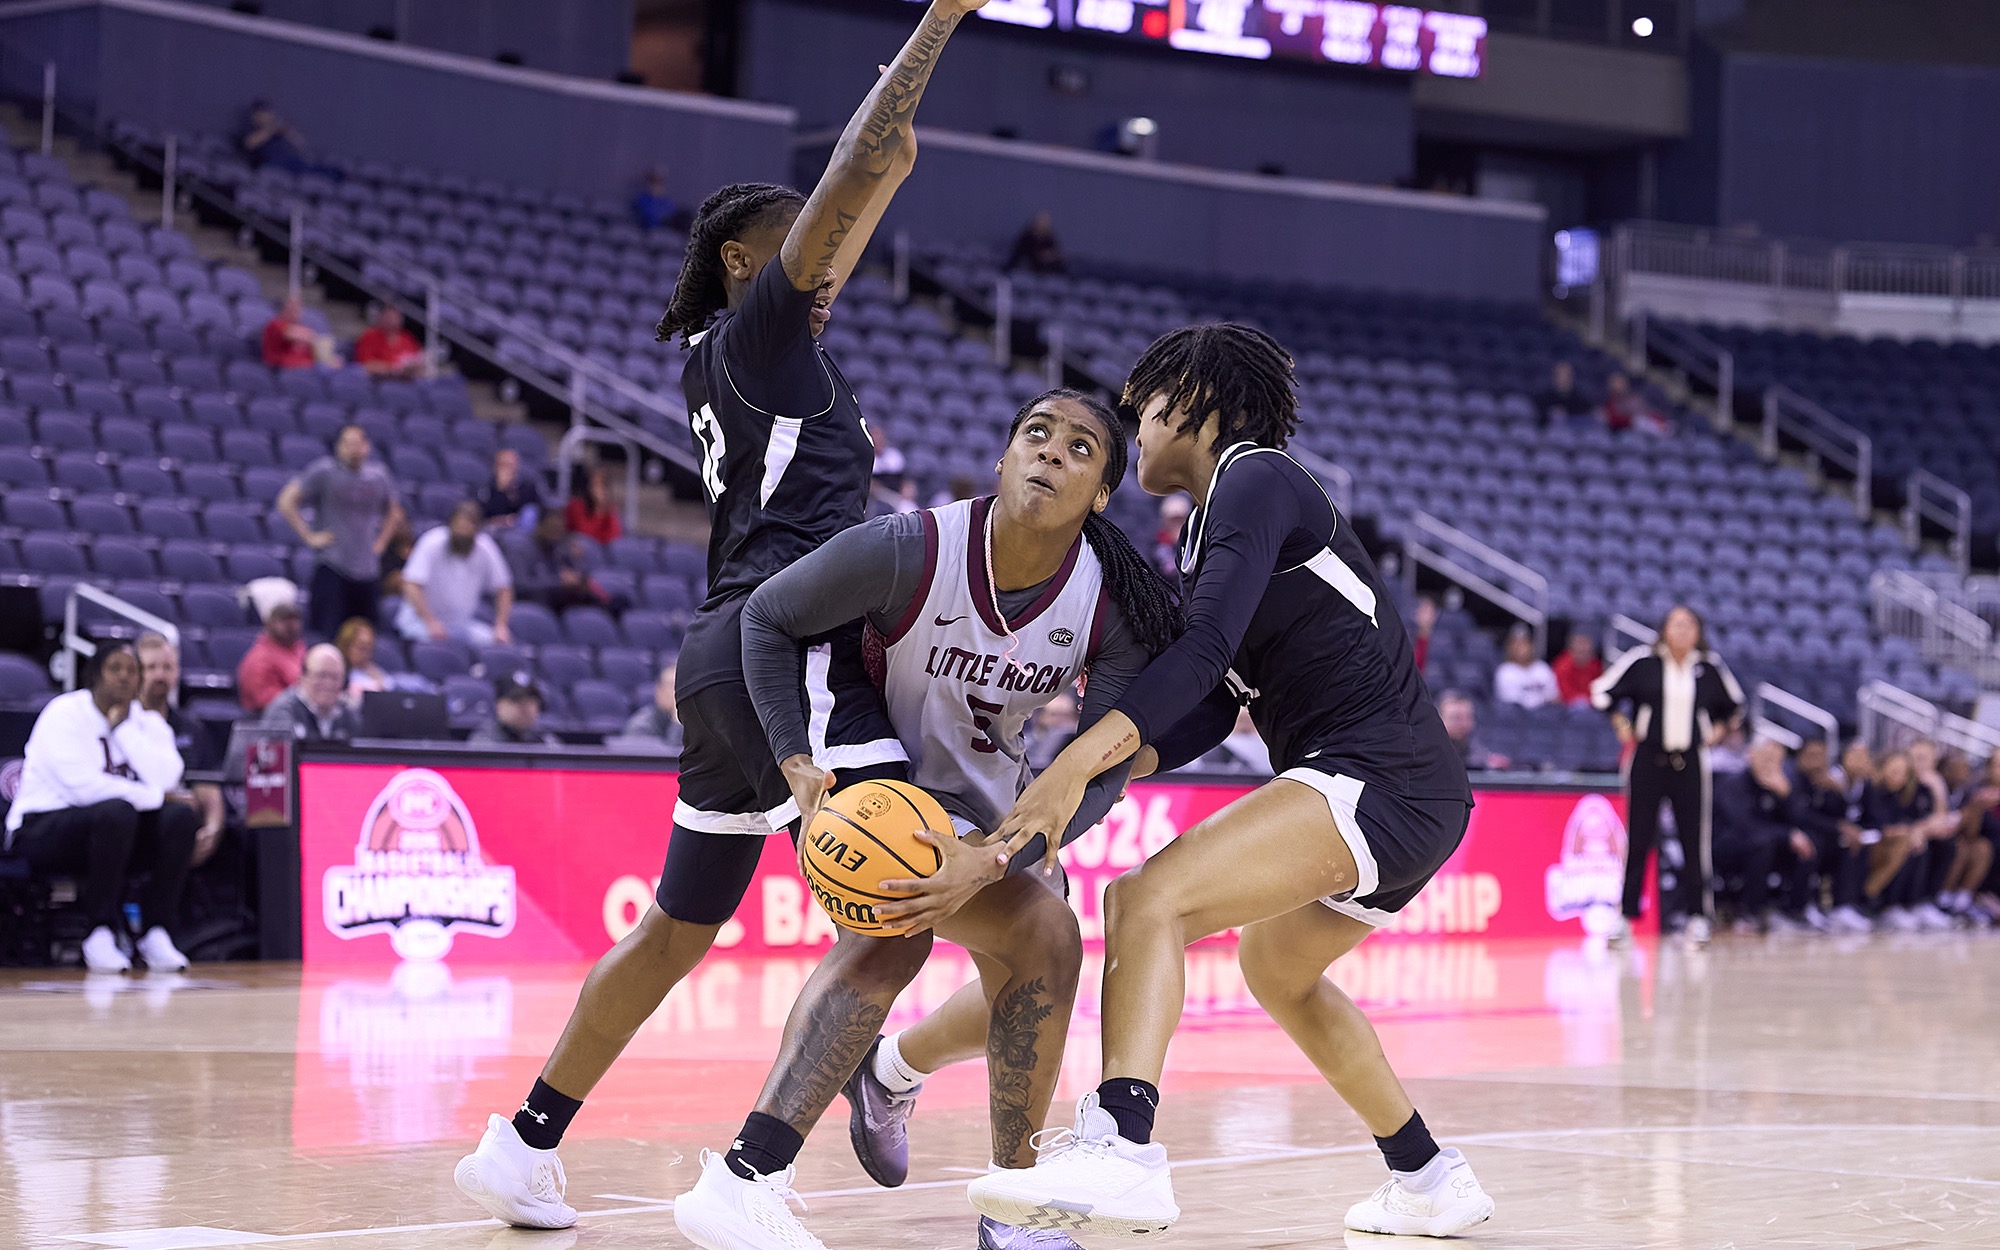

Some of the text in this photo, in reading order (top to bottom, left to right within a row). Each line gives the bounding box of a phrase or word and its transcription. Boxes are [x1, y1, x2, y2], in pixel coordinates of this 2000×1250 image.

[691, 402, 727, 503] 12
[1052, 632, 1072, 644] OVC
[924, 645, 1071, 694] LITTLE ROCK
[966, 693, 1005, 754] 5
[814, 830, 868, 872] EVO
[1058, 792, 1178, 869] 026
[804, 867, 880, 924] Wilso
